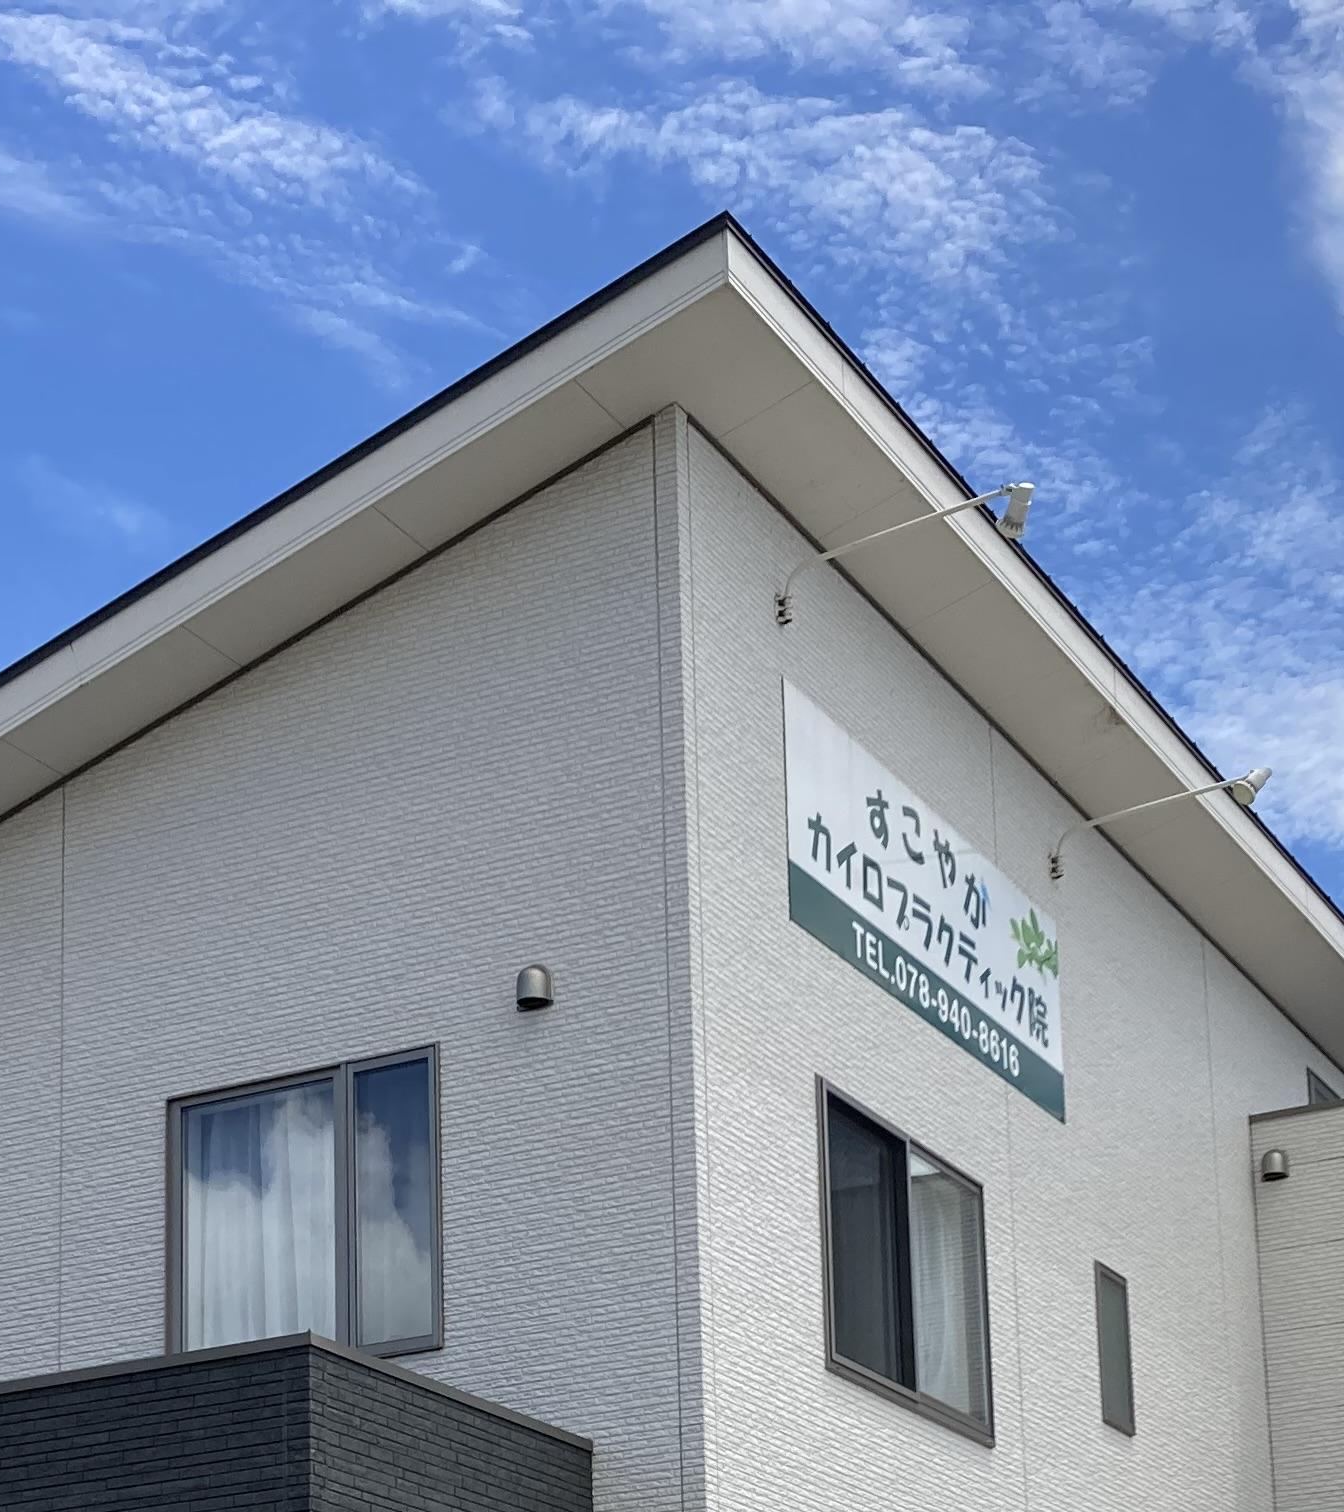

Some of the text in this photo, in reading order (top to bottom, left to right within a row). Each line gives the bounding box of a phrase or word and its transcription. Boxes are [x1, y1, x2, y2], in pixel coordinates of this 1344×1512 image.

[807, 812, 1049, 1048] カイロプラクティック院
[866, 789, 990, 929] すこやか
[852, 922, 1019, 1077] TEL.078-940-8616
